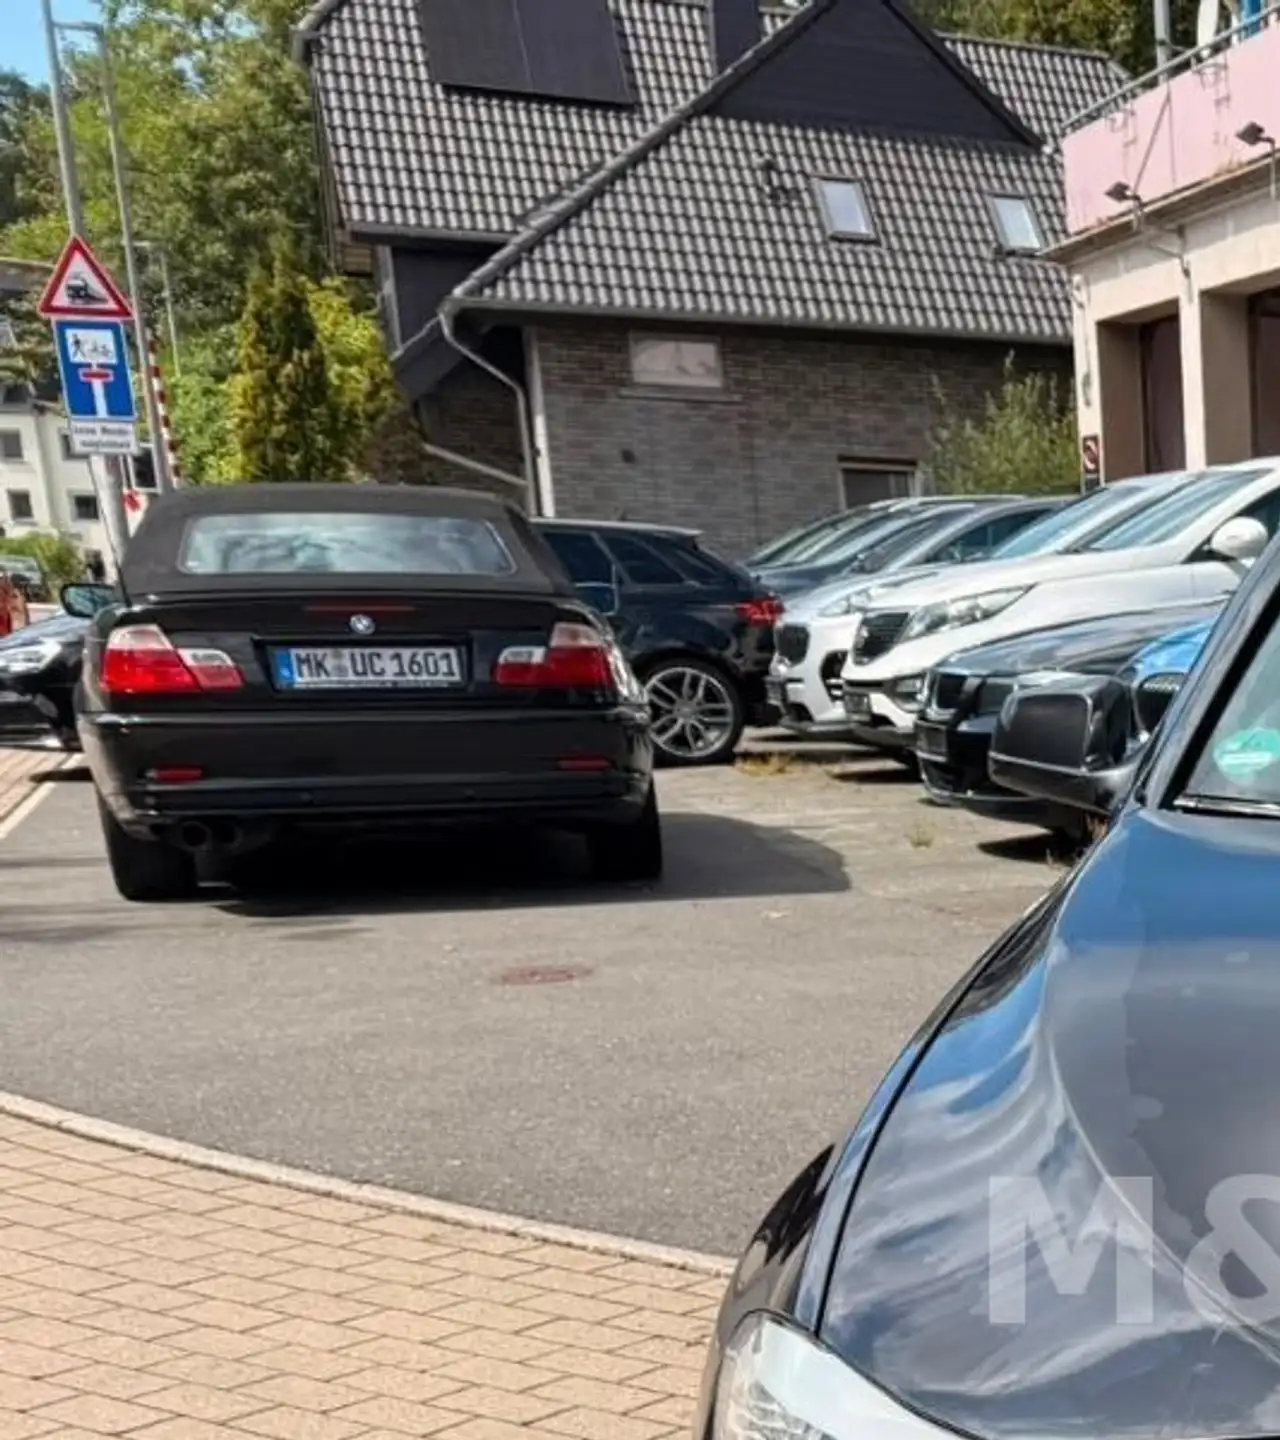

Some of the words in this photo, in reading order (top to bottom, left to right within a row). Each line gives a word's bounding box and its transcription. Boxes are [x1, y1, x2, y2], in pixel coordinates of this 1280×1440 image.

[295, 652, 331, 677] MK
[351, 653, 385, 677] UC
[389, 653, 455, 677] 1601
